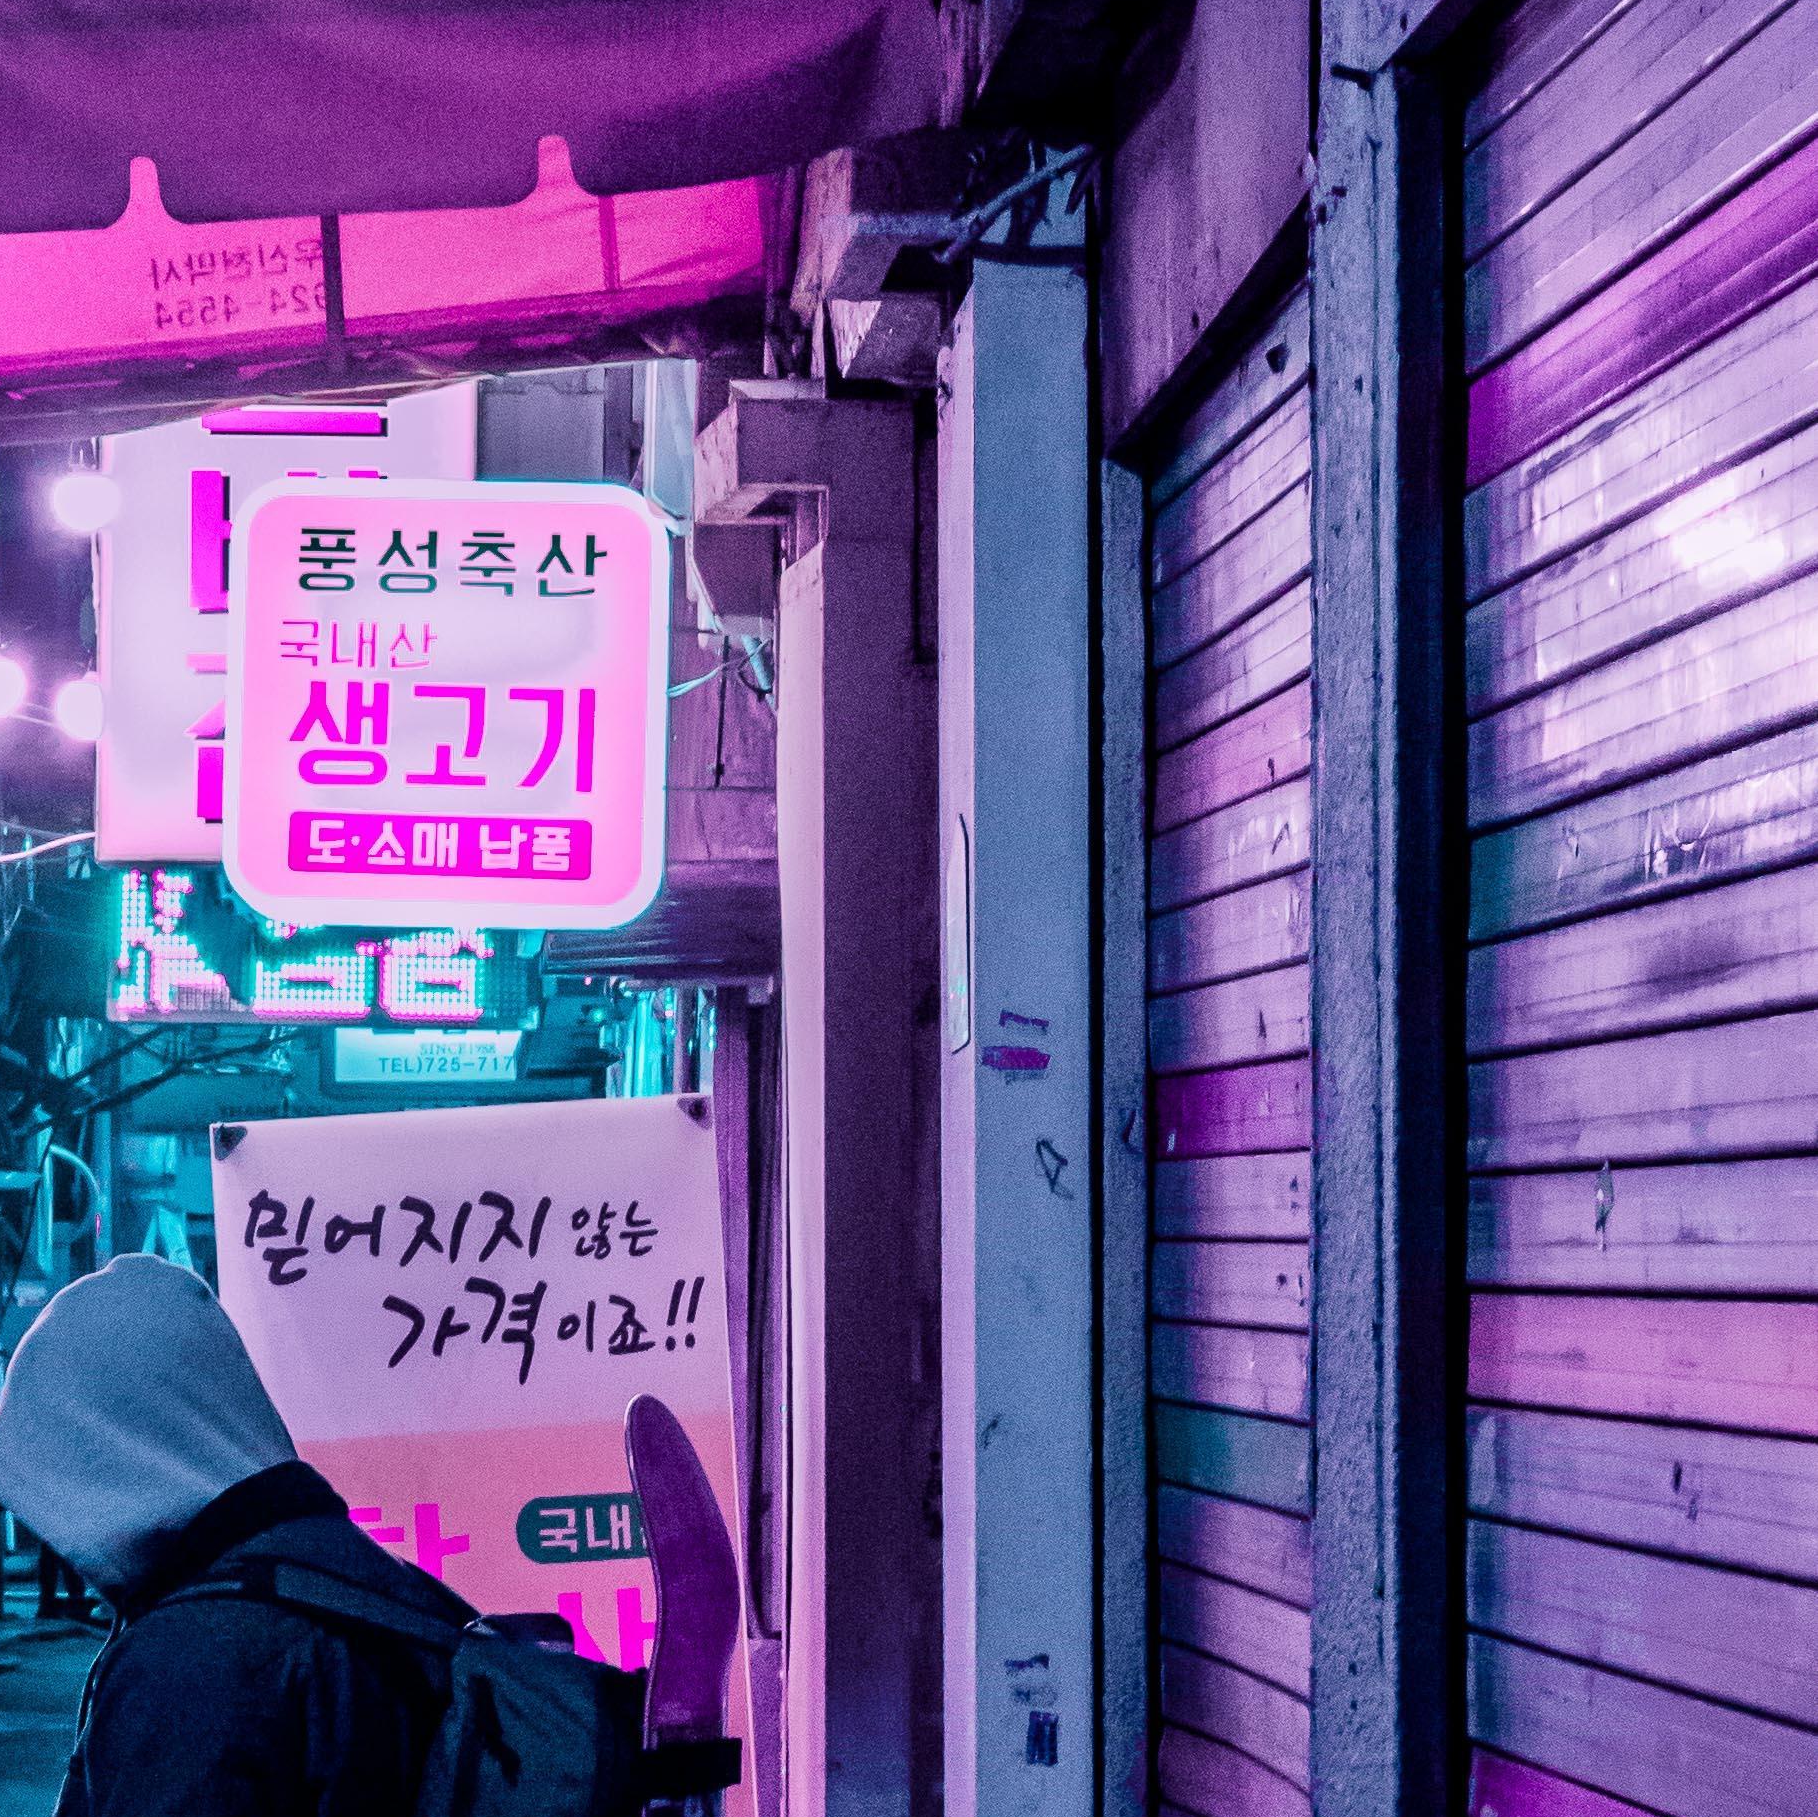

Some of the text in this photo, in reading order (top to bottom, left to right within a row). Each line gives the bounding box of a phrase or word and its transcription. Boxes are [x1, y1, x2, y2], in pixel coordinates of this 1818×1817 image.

[296, 526, 609, 598] 풍성축산
[278, 618, 438, 669] 국내산
[289, 679, 598, 794] 생고기
[479, 823, 573, 872] 납품
[243, 1189, 660, 1286] 믿어지지 않는
[382, 1276, 706, 1385] 가격이죠!!
[538, 1505, 648, 1554] 국내
